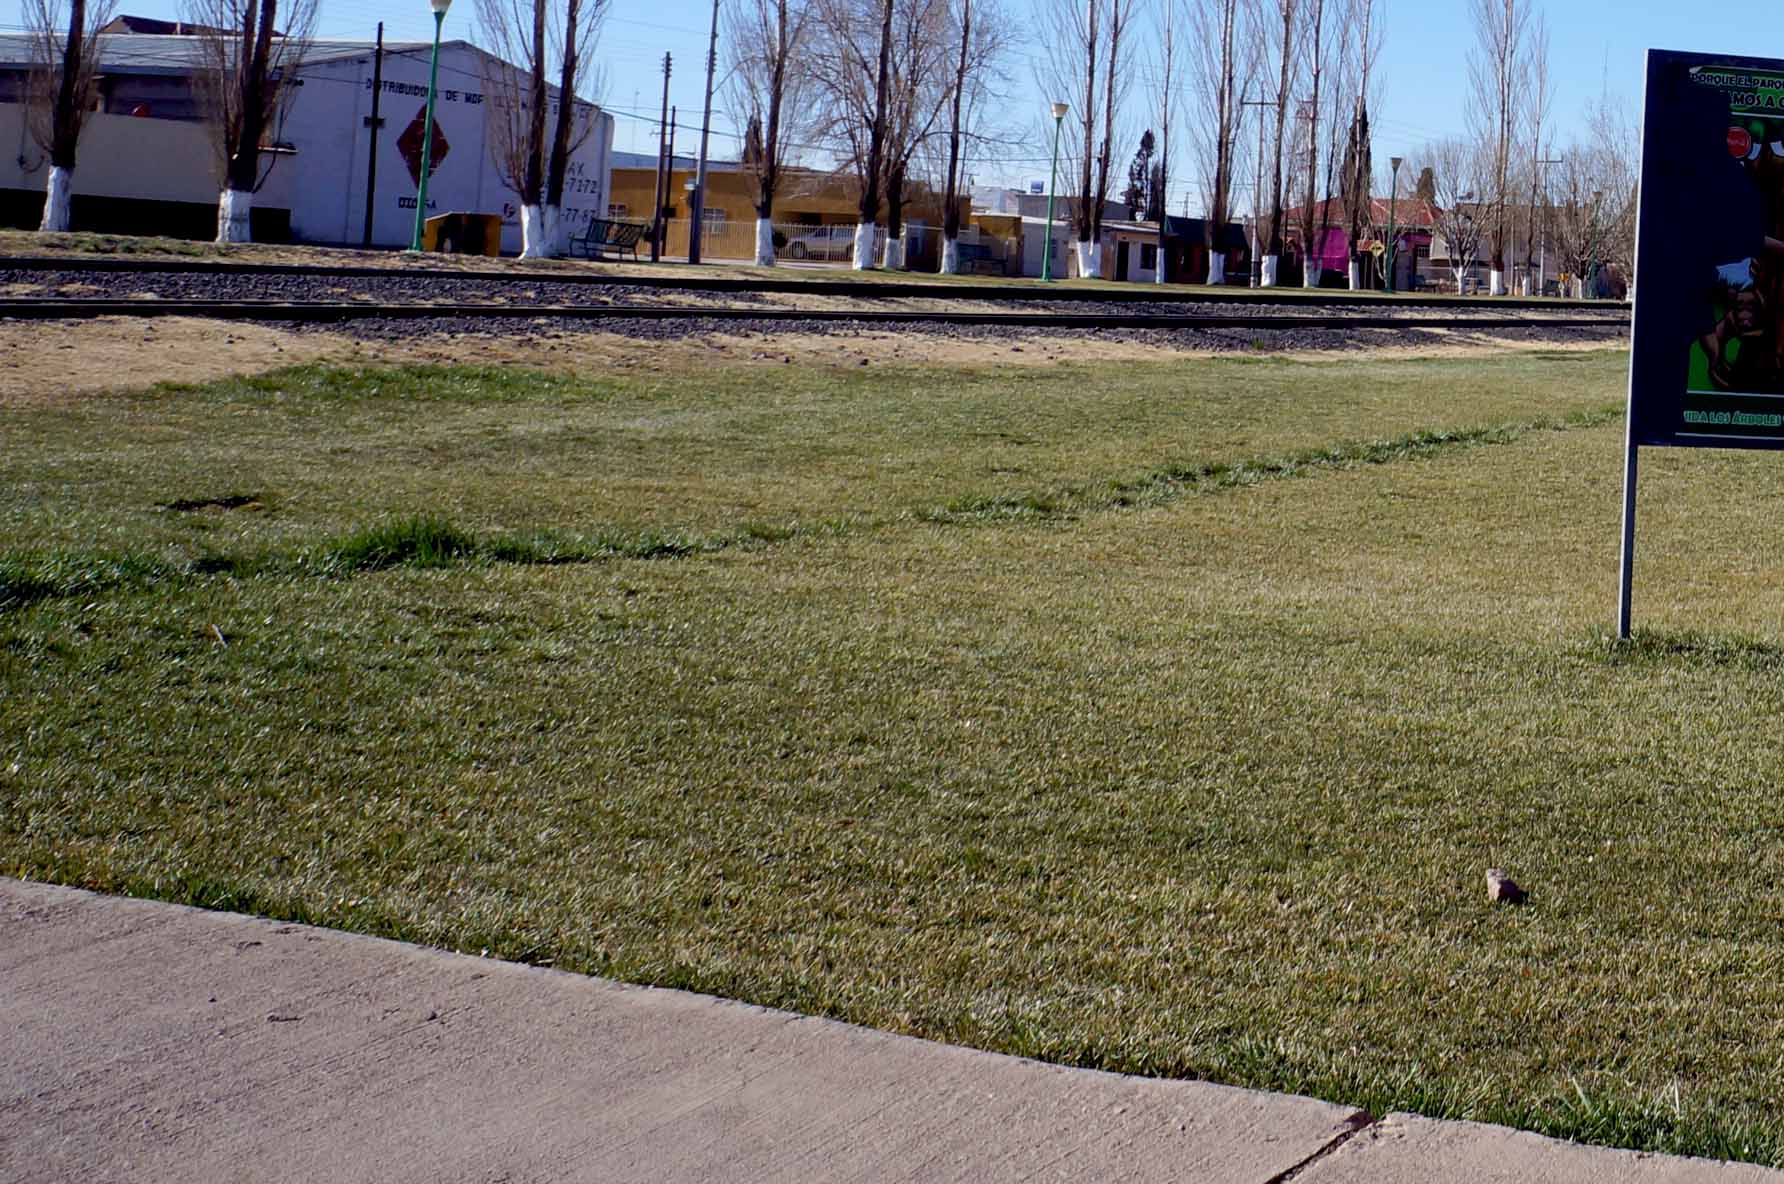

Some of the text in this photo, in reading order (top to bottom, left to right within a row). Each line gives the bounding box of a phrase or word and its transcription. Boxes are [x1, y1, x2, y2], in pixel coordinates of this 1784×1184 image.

[1738, 76, 1752, 87] EL
[445, 90, 457, 102] DE
[1765, 95, 1775, 107] A
